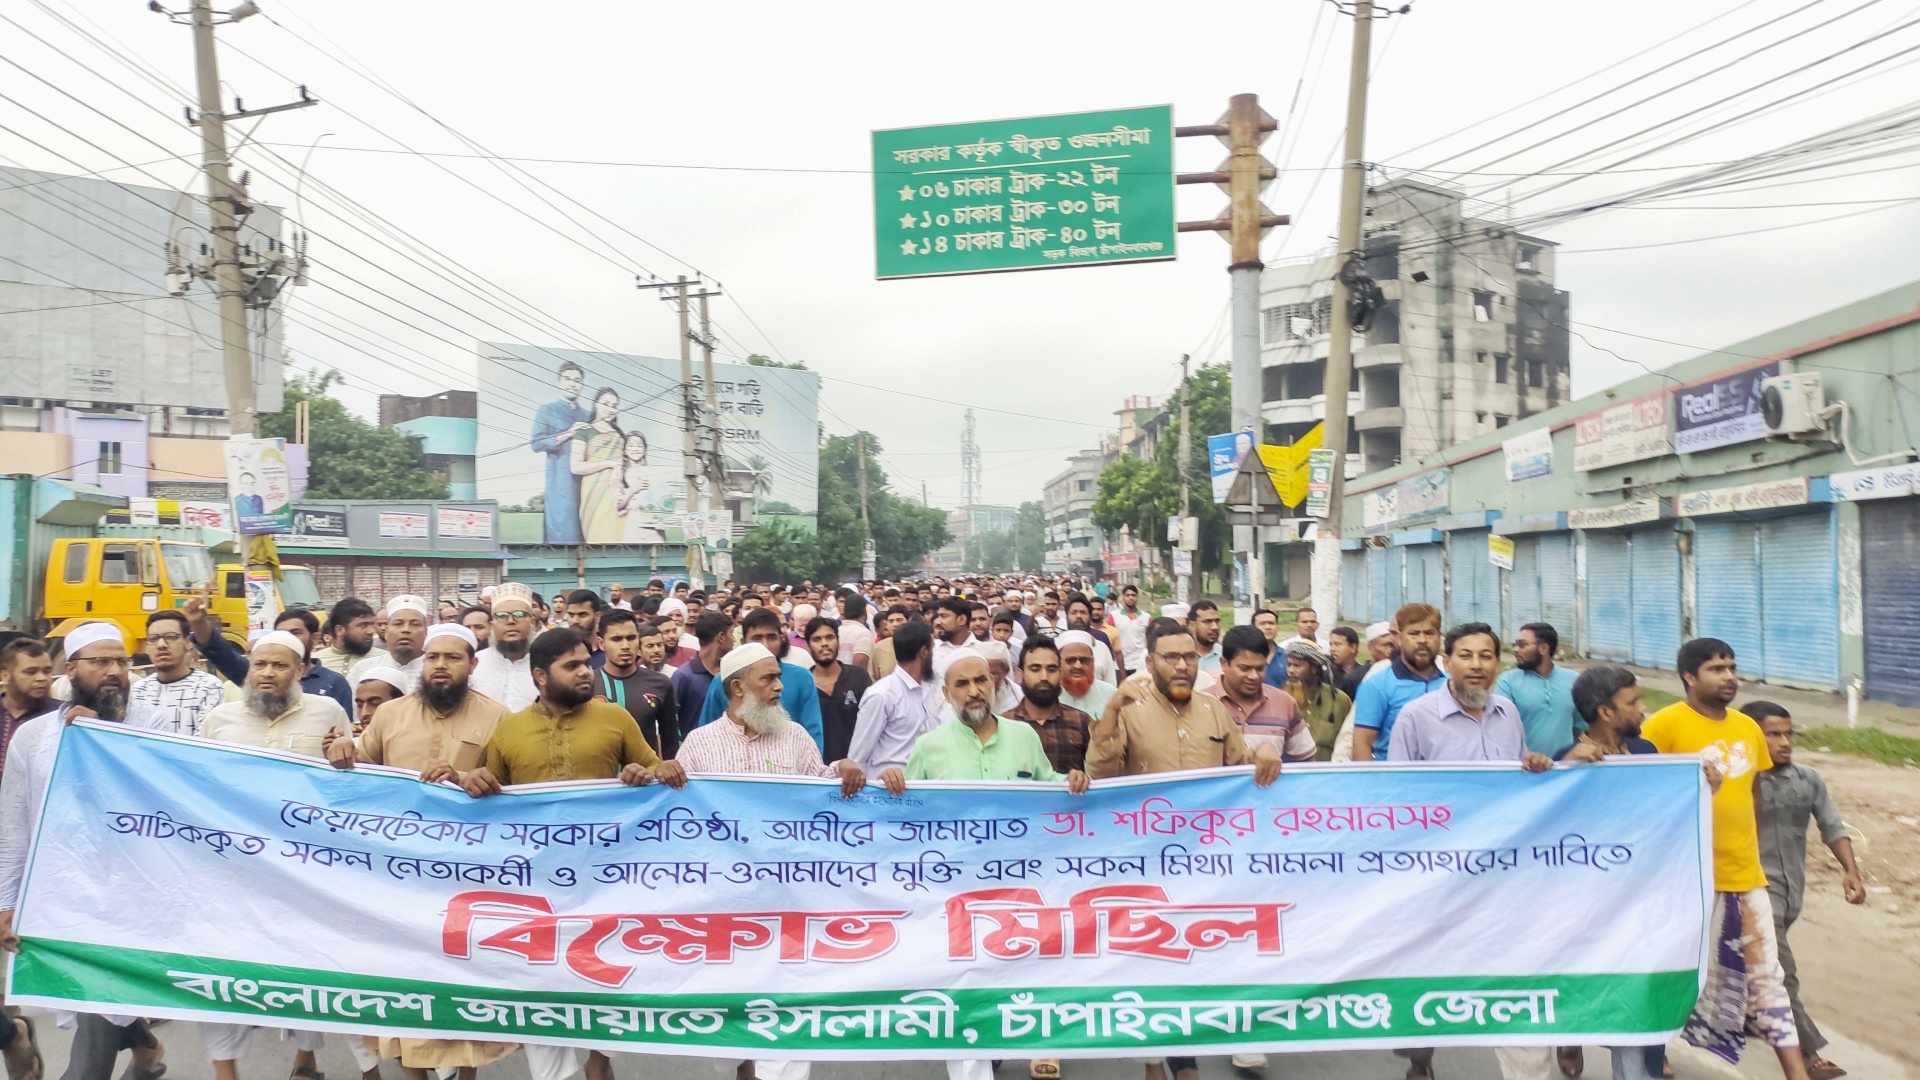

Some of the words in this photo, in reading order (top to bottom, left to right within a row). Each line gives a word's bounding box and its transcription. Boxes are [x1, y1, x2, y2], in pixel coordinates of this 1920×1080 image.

[893, 146, 952, 164] সরকার
[1067, 125, 1152, 149] ওজনসীমা
[919, 182, 950, 198] ০৬
[952, 176, 1003, 197] চাকার
[1090, 162, 1120, 185] টন
[919, 211, 950, 228] ১০
[952, 203, 1004, 225] চাকার
[1090, 192, 1121, 214] টন
[919, 235, 949, 255] ১৪
[954, 231, 1005, 251] চাকার
[1092, 218, 1122, 240] টন
[279, 799, 489, 845] কেয়ারটেকার
[501, 821, 622, 851] সরকার
[762, 811, 876, 848] আমীরে
[888, 816, 1028, 845] জামায়াত
[1041, 811, 1095, 838] ডা.
[1112, 796, 1255, 846] শফিকুর
[1271, 804, 1453, 837] রহমানসহ
[105, 811, 271, 860] আটককৃত
[280, 840, 373, 872] সকল
[547, 867, 578, 887] ও
[891, 850, 963, 893] মুক্তি
[976, 858, 1042, 881] এবং
[1055, 855, 1146, 879] সকল
[1160, 843, 1234, 877] মিথ্যা
[1247, 852, 1345, 876] মামলা
[1356, 848, 1518, 876] প্রত্যাহারের
[1531, 833, 1634, 872] দাবিতে
[439, 887, 910, 989] বিক্ষোভ
[942, 885, 1297, 963] মিছিল
[165, 970, 435, 1021] বাংলাদেশ
[451, 995, 728, 1037] জামায়াতে
[746, 990, 979, 1045] ইসলামী,
[997, 990, 1393, 1040] চাঁপাইনবাবগঞ্জ
[1412, 987, 1559, 1026] জেলা
